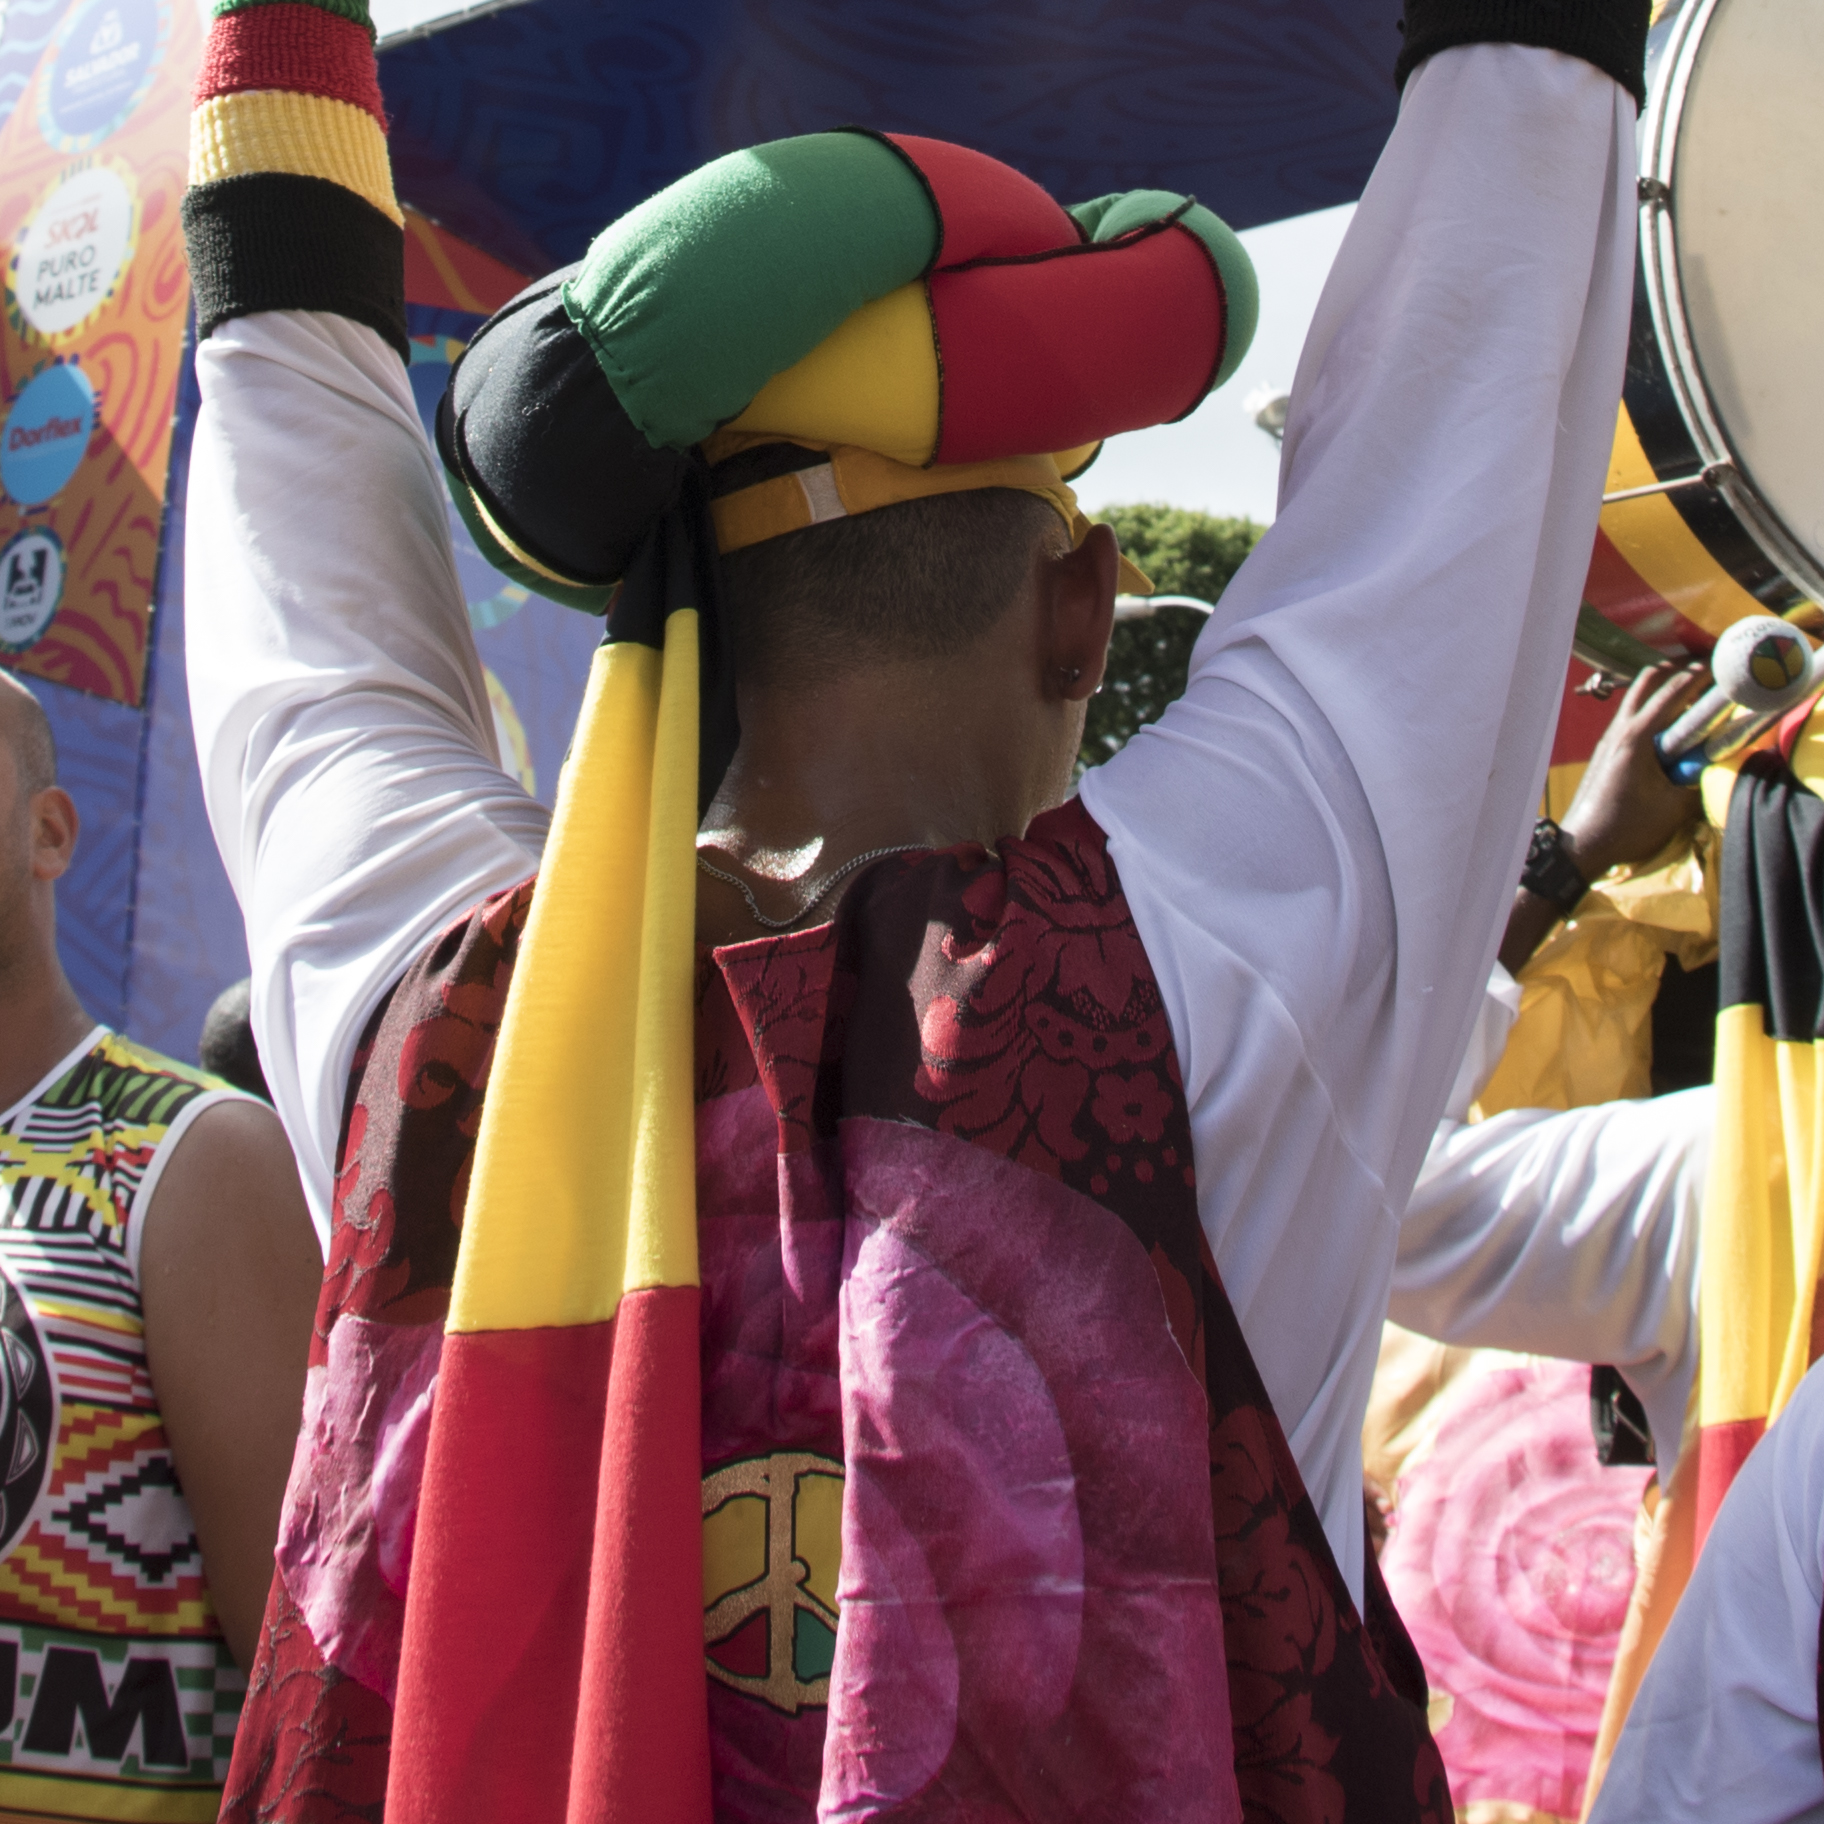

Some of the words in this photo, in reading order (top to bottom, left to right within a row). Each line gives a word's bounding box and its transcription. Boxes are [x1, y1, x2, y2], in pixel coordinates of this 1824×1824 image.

[36, 243, 97, 283] PURO
[32, 267, 101, 311] MALTE
[8, 411, 83, 453] Dorflex
